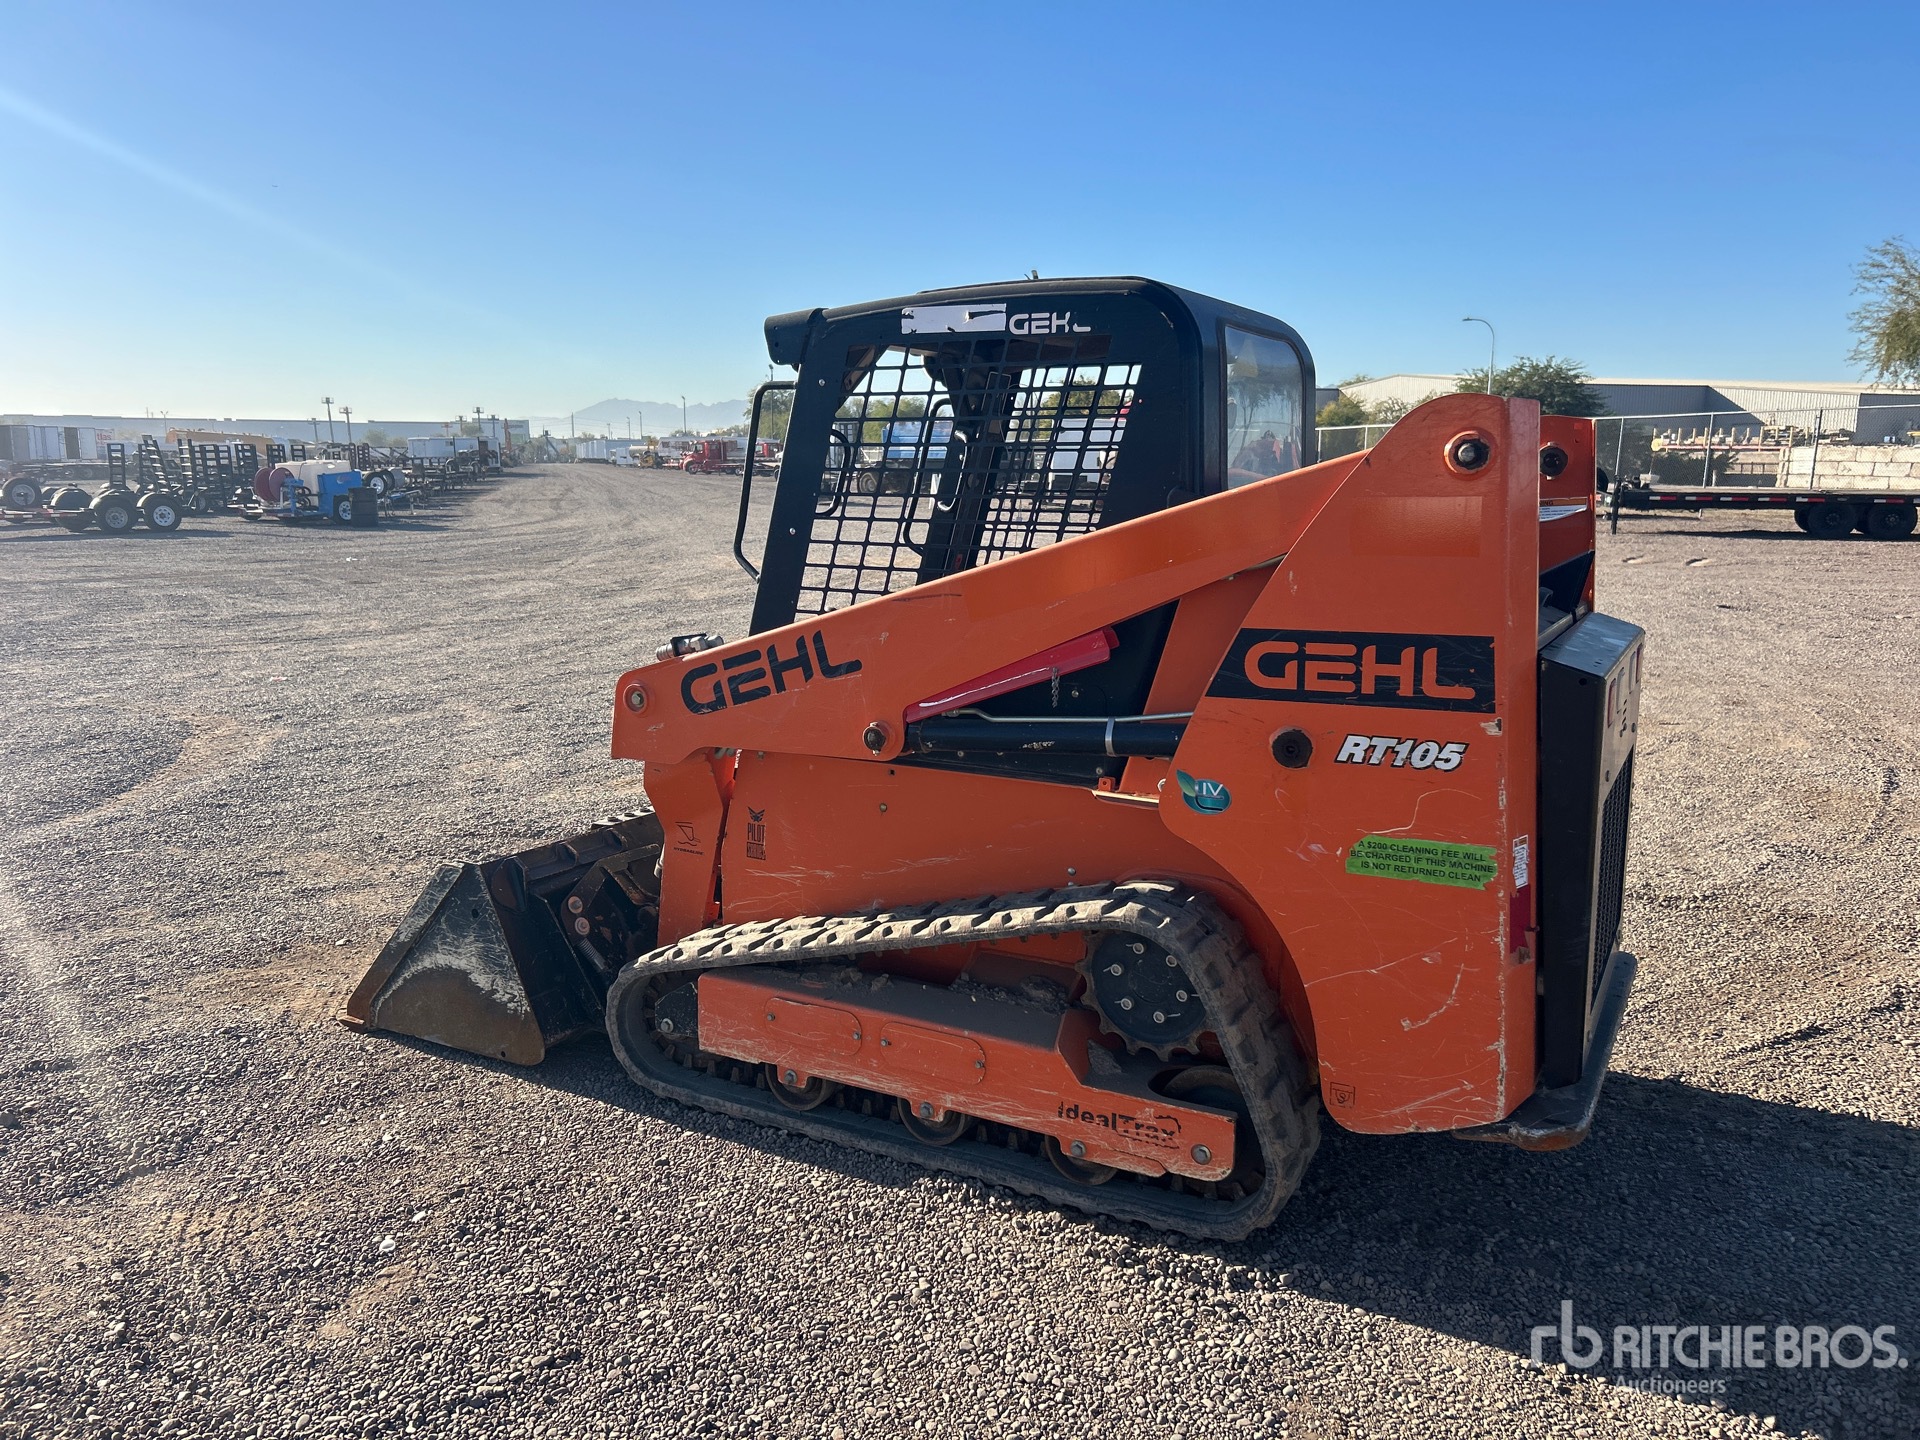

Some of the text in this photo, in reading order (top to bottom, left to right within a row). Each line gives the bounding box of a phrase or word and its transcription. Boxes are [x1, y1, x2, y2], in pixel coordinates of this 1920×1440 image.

[680, 630, 863, 715] GEHL
[1244, 640, 1476, 700] GEHL
[1334, 733, 1470, 772] RT105
[1358, 839, 1486, 862] A $200 CLEANING FEE WILL
[1366, 850, 1411, 863] CHARGED
[1425, 858, 1446, 867] THIS
[1448, 861, 1494, 873] MACHINE
[1360, 860, 1481, 882] IS NOT RETURNED CLEAN
